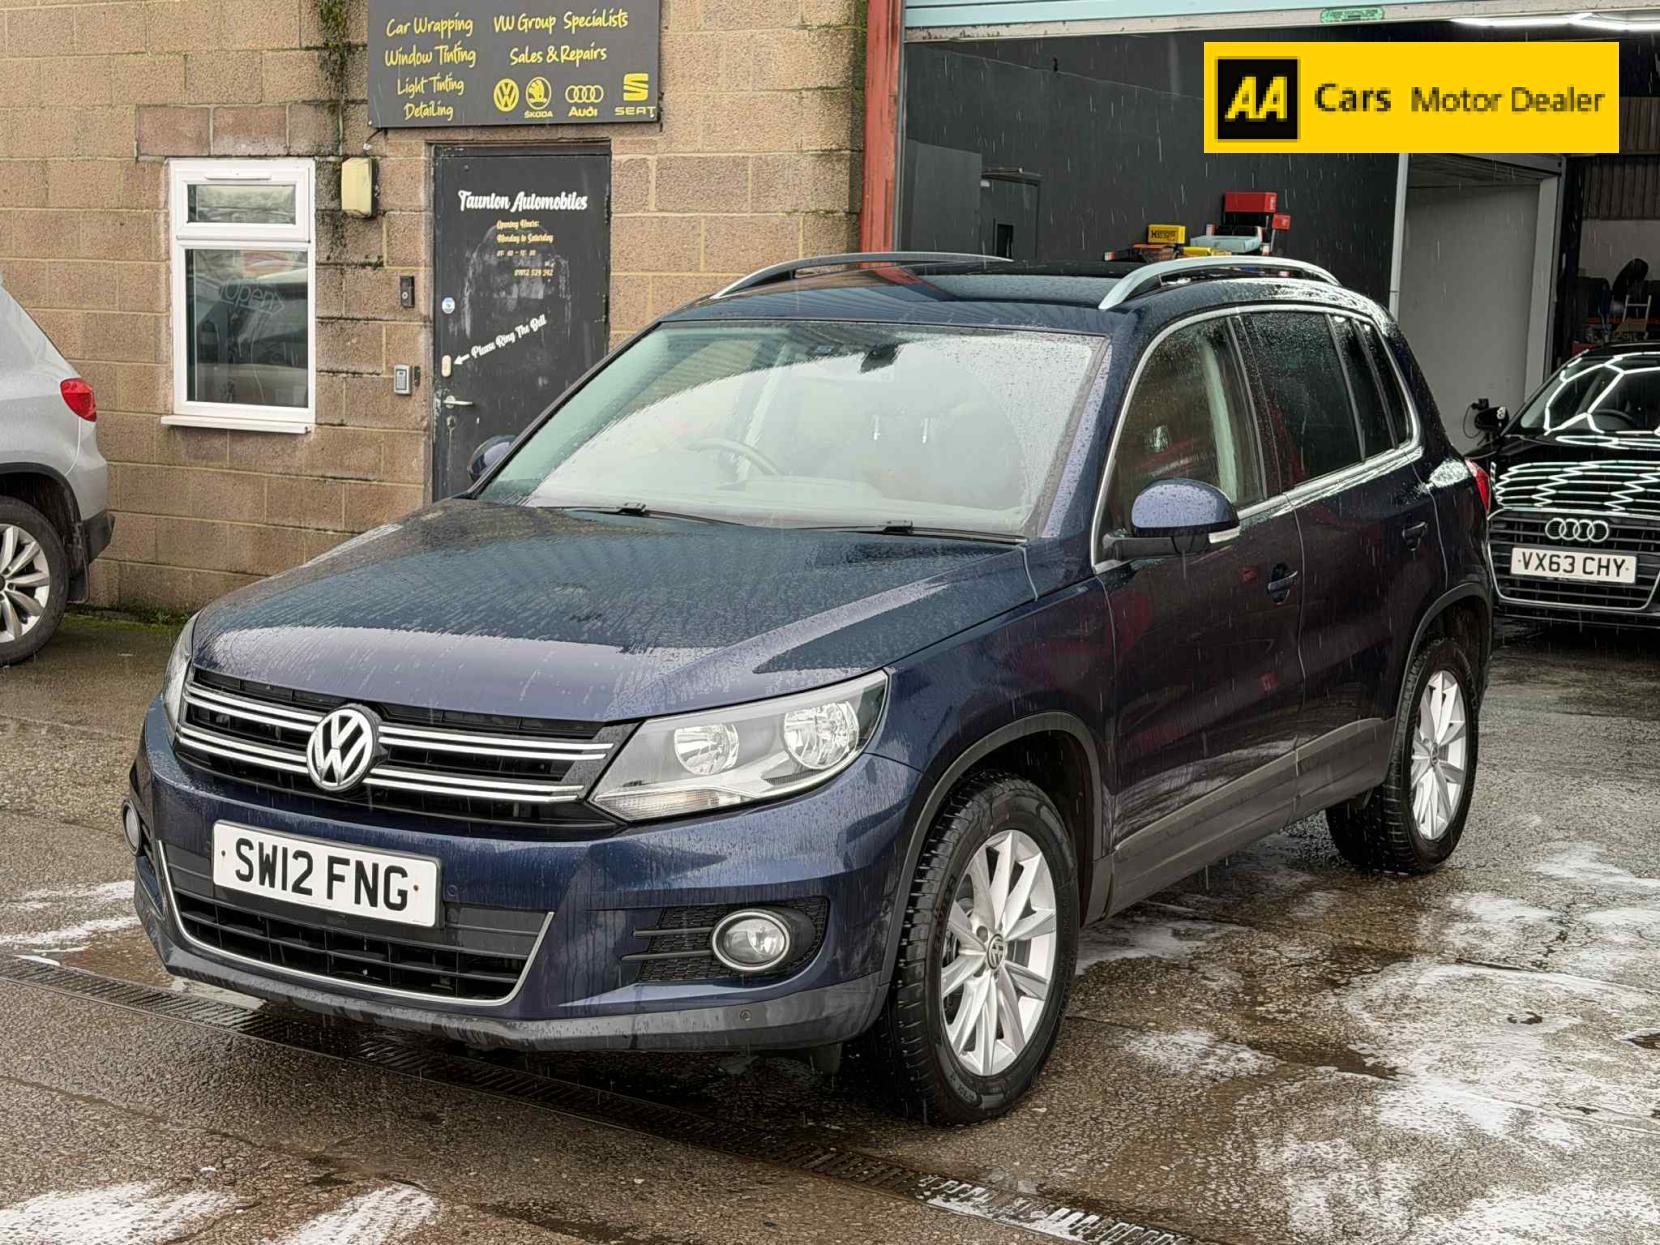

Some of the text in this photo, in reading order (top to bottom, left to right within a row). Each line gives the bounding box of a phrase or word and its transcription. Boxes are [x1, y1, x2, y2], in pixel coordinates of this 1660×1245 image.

[386, 12, 474, 39] Car Wrapping
[494, 9, 629, 36] VW Group Specialists
[385, 42, 477, 67] Window Tinting
[510, 42, 608, 67] Sales & Repairs
[397, 72, 465, 99] Light Tinting
[404, 98, 455, 121] Detailing
[568, 106, 598, 117] Audi
[614, 106, 656, 116] SEAT
[458, 190, 588, 212] Taunton Automobiles
[470, 314, 547, 359] Please Ring The Bell
[1522, 552, 1626, 578] VX63 CHY
[235, 838, 409, 912] SW12 FNG
